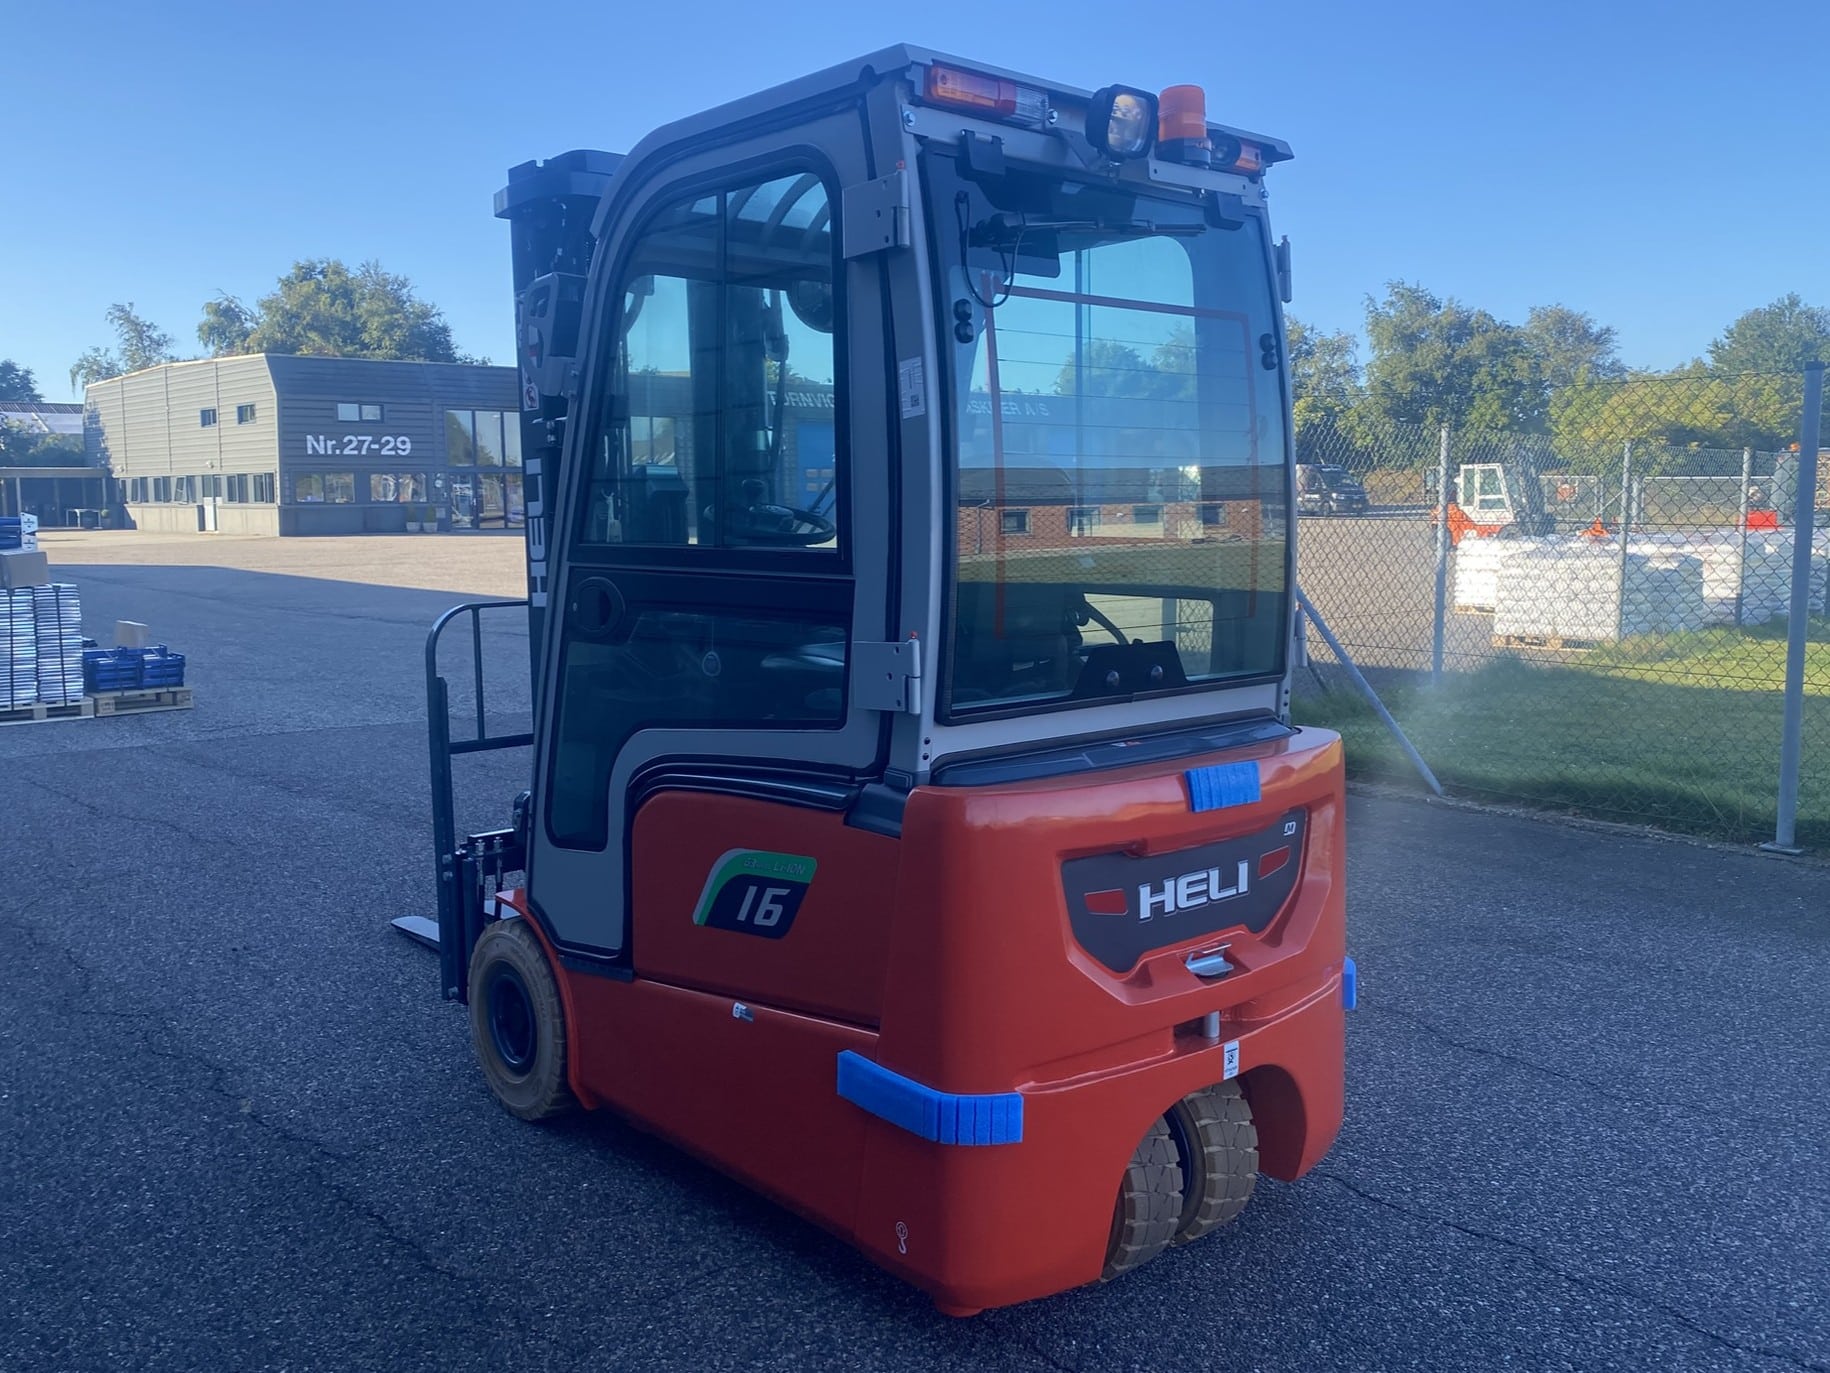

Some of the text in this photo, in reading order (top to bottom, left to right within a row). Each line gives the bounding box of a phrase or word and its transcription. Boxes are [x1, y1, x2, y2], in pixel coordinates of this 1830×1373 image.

[525, 457, 547, 608] HELI
[736, 885, 791, 927] 16
[1138, 860, 1250, 921] HELI
